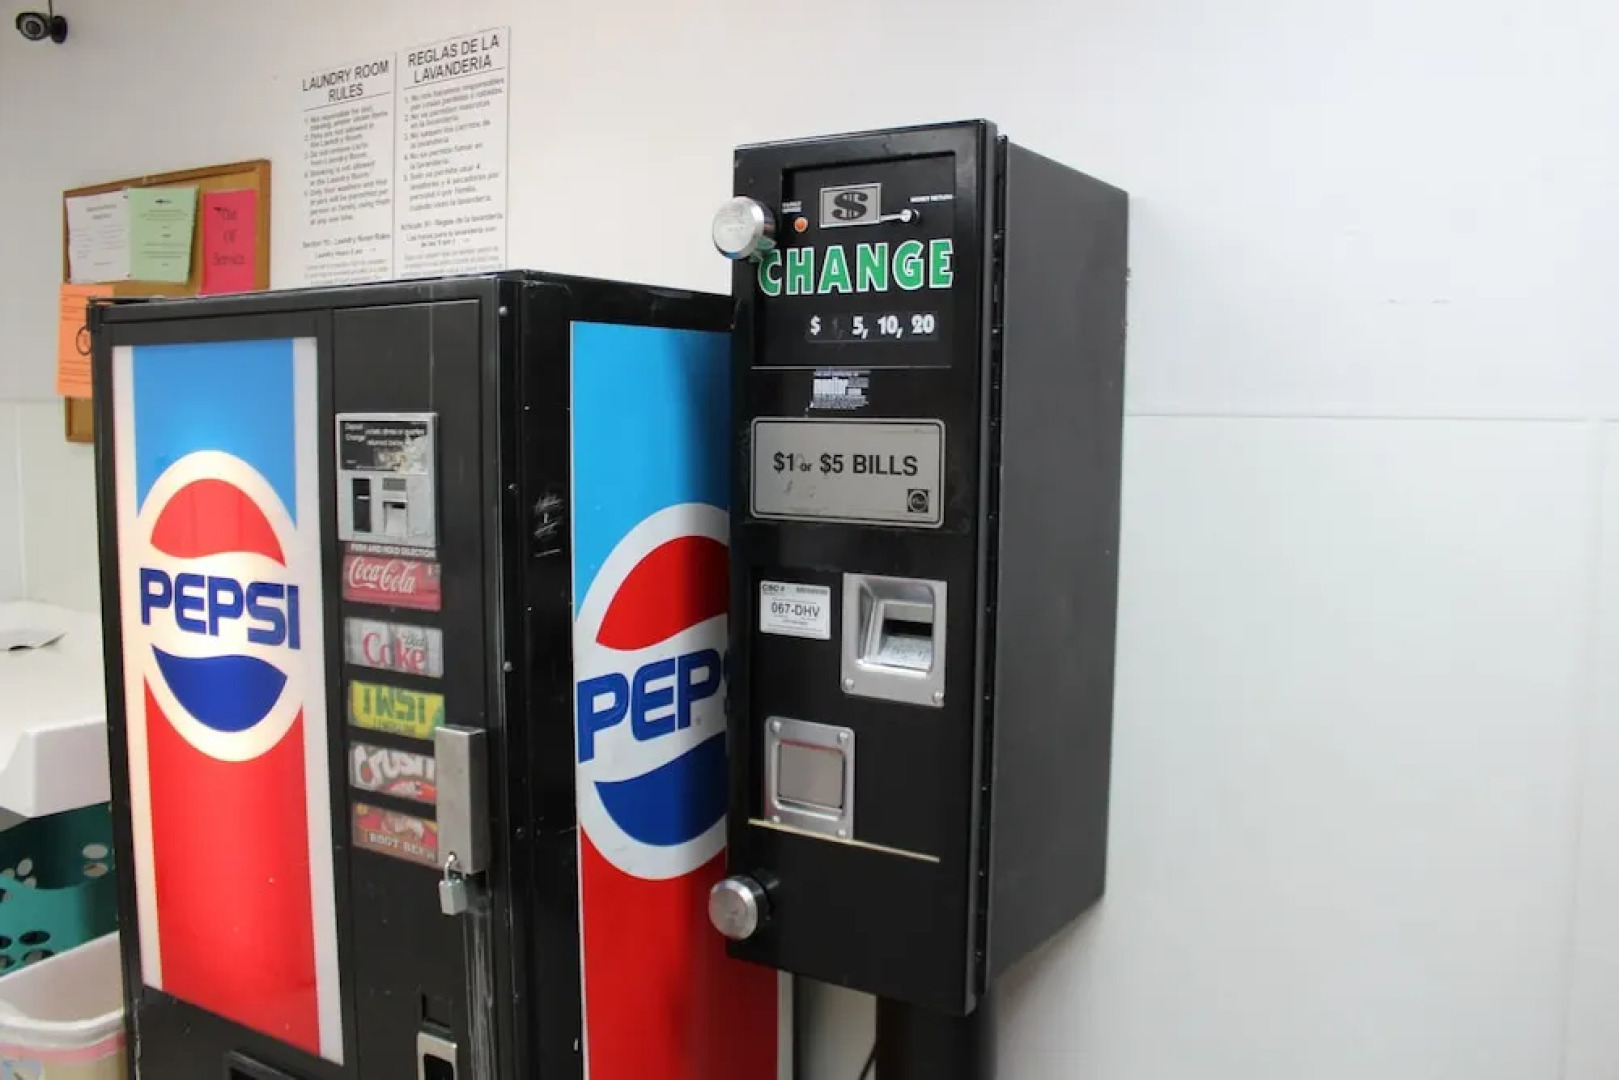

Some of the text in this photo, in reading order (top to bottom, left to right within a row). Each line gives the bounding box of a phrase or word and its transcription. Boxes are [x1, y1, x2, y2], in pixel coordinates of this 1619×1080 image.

[408, 34, 499, 67] REGLAS DE LA
[302, 60, 388, 92] LAUNDRY ROOM
[414, 55, 492, 83] LAVANDERIA
[328, 84, 364, 102] RULES
[757, 238, 954, 297] CHANGE
[810, 315, 822, 336] $
[852, 315, 869, 339] 5,
[877, 314, 903, 339] 10,
[911, 314, 935, 334] 20
[800, 462, 812, 472] or
[820, 452, 844, 476] $5
[852, 454, 919, 476] BILLS
[140, 568, 301, 650] PEPSI
[772, 602, 820, 618] 067-DHV
[362, 631, 428, 674] Coke
[577, 648, 727, 764] PEP
